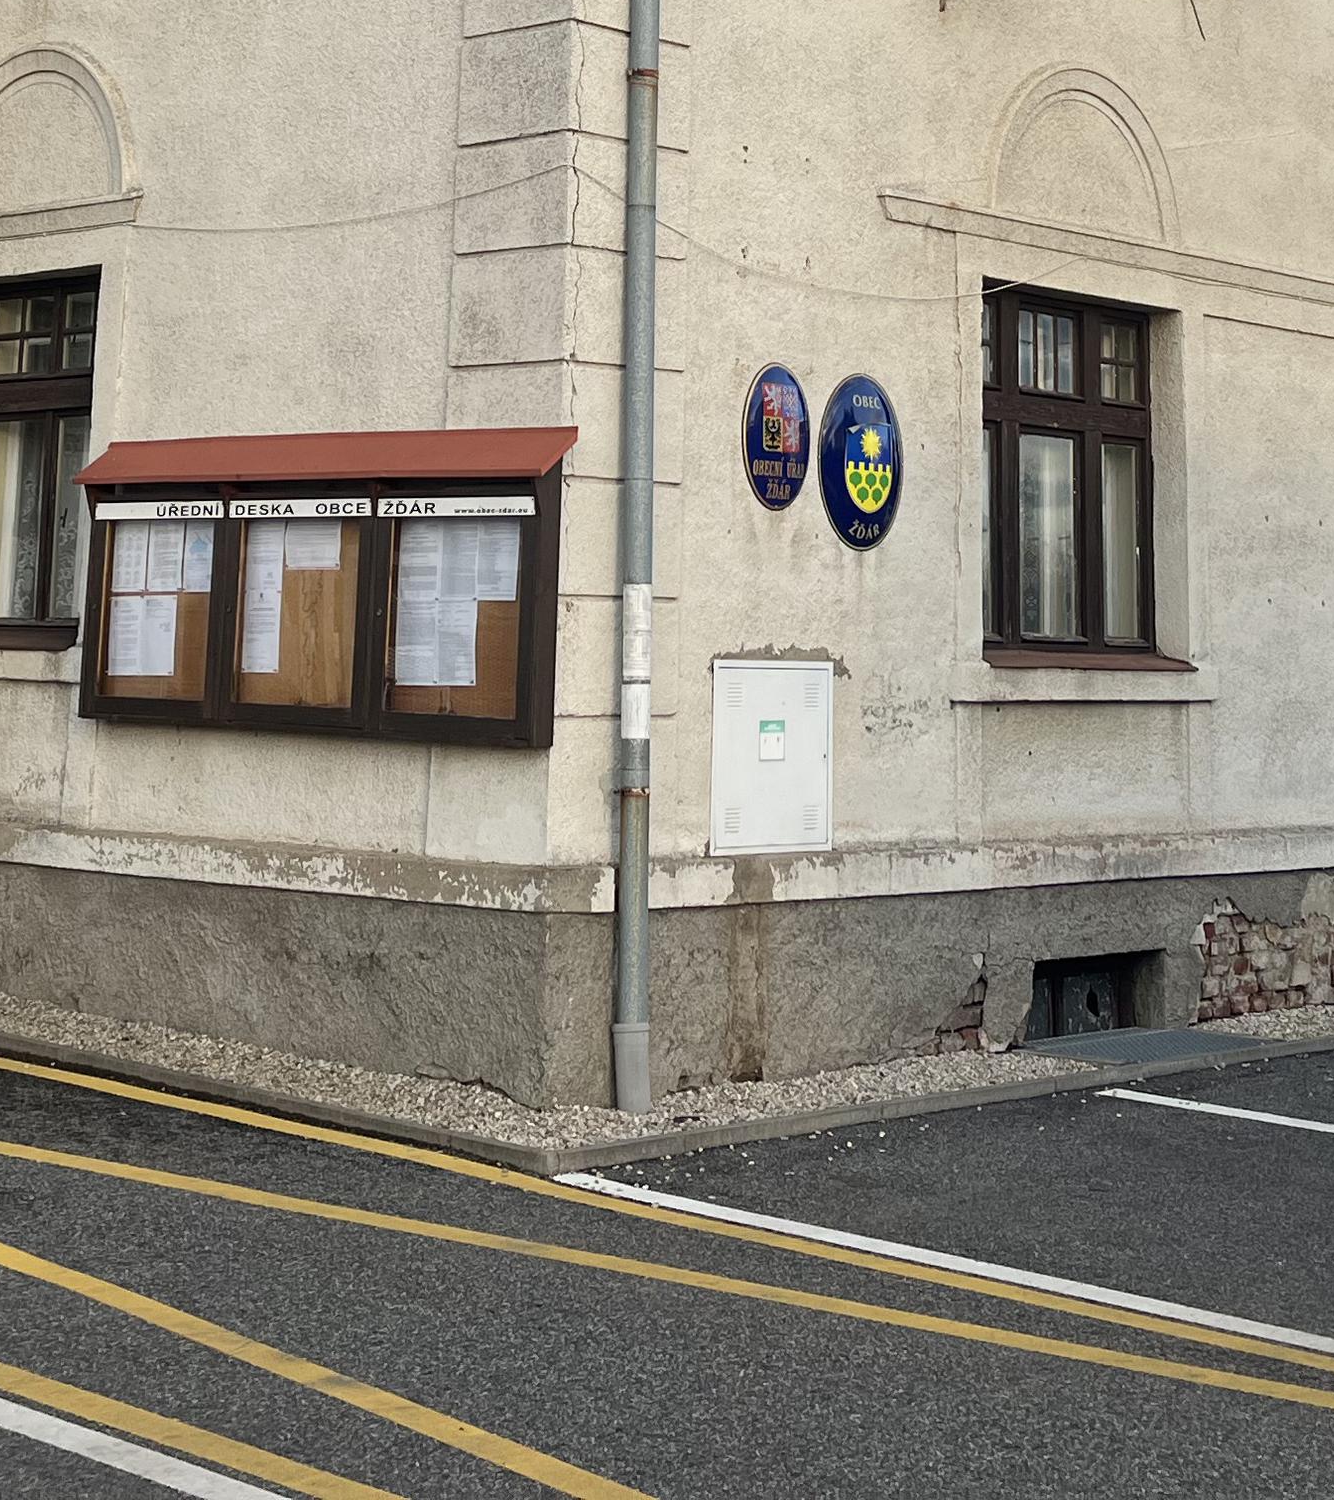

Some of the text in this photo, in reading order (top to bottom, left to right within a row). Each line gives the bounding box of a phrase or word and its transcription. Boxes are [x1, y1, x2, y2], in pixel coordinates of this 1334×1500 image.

[852, 394, 881, 409] OBEC
[752, 456, 784, 477] OBECNÍ
[766, 478, 791, 500] ŽĎÁR
[156, 502, 219, 517] ÚŘEDNÍ
[235, 503, 294, 516] DESKA
[315, 502, 367, 514] OBCE
[383, 500, 436, 515] ŽĎÁR
[848, 519, 881, 540] ŽĎÁR
